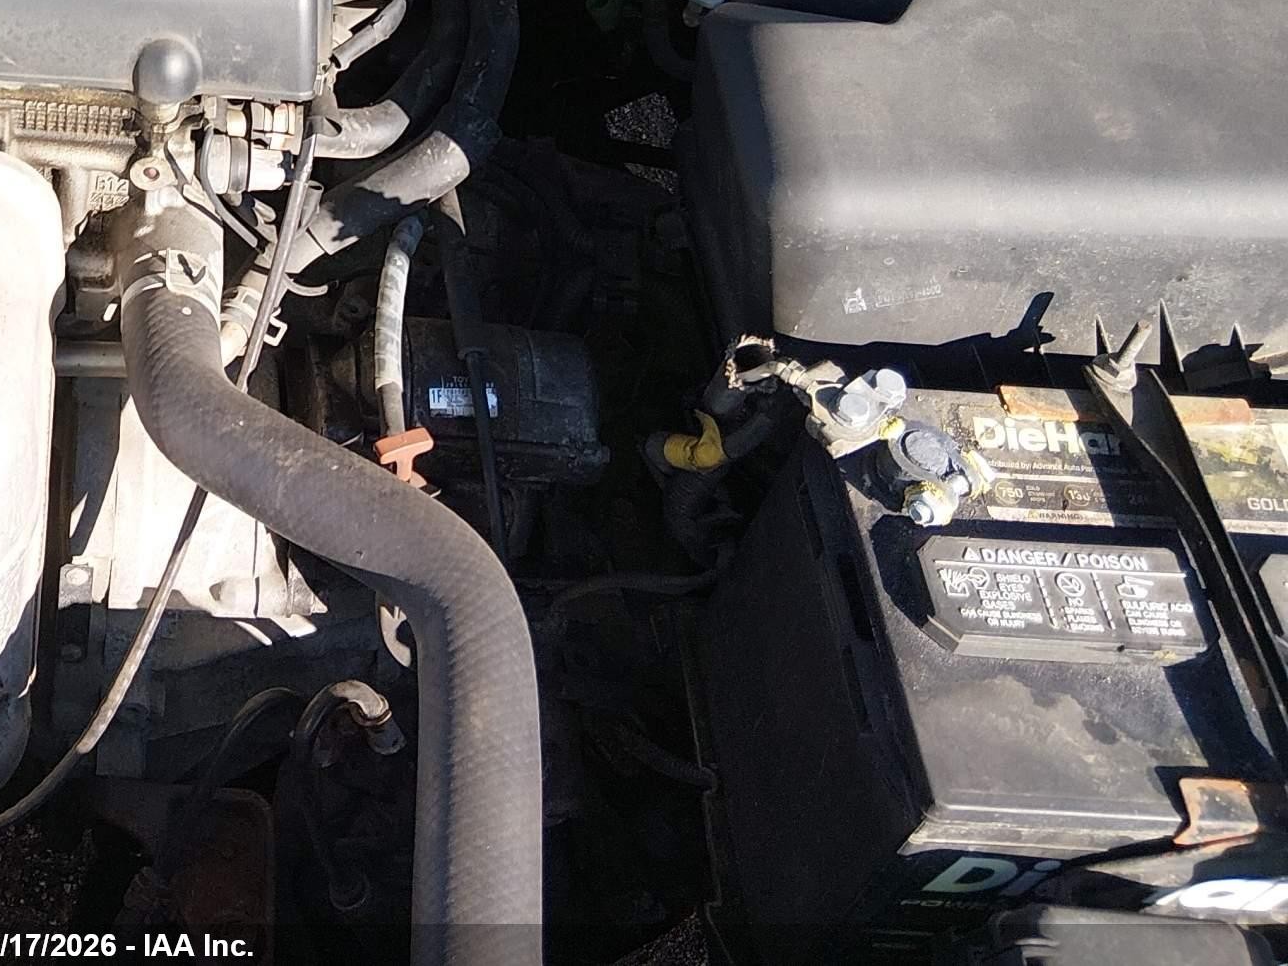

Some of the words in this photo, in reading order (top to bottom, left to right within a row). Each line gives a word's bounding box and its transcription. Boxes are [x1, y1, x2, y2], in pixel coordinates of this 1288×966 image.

[972, 416, 1121, 457] DieHar
[998, 487, 1023, 498] 750
[980, 548, 1062, 566] DANGER
[1076, 553, 1148, 571] POISON
[995, 573, 1031, 584] SHIELD
[999, 583, 1025, 593] EYES
[979, 590, 1033, 602] EXPLOSIVE
[982, 599, 1016, 611] GASES
[1067, 597, 1084, 607] NO
[1171, 602, 1194, 613] ACID
